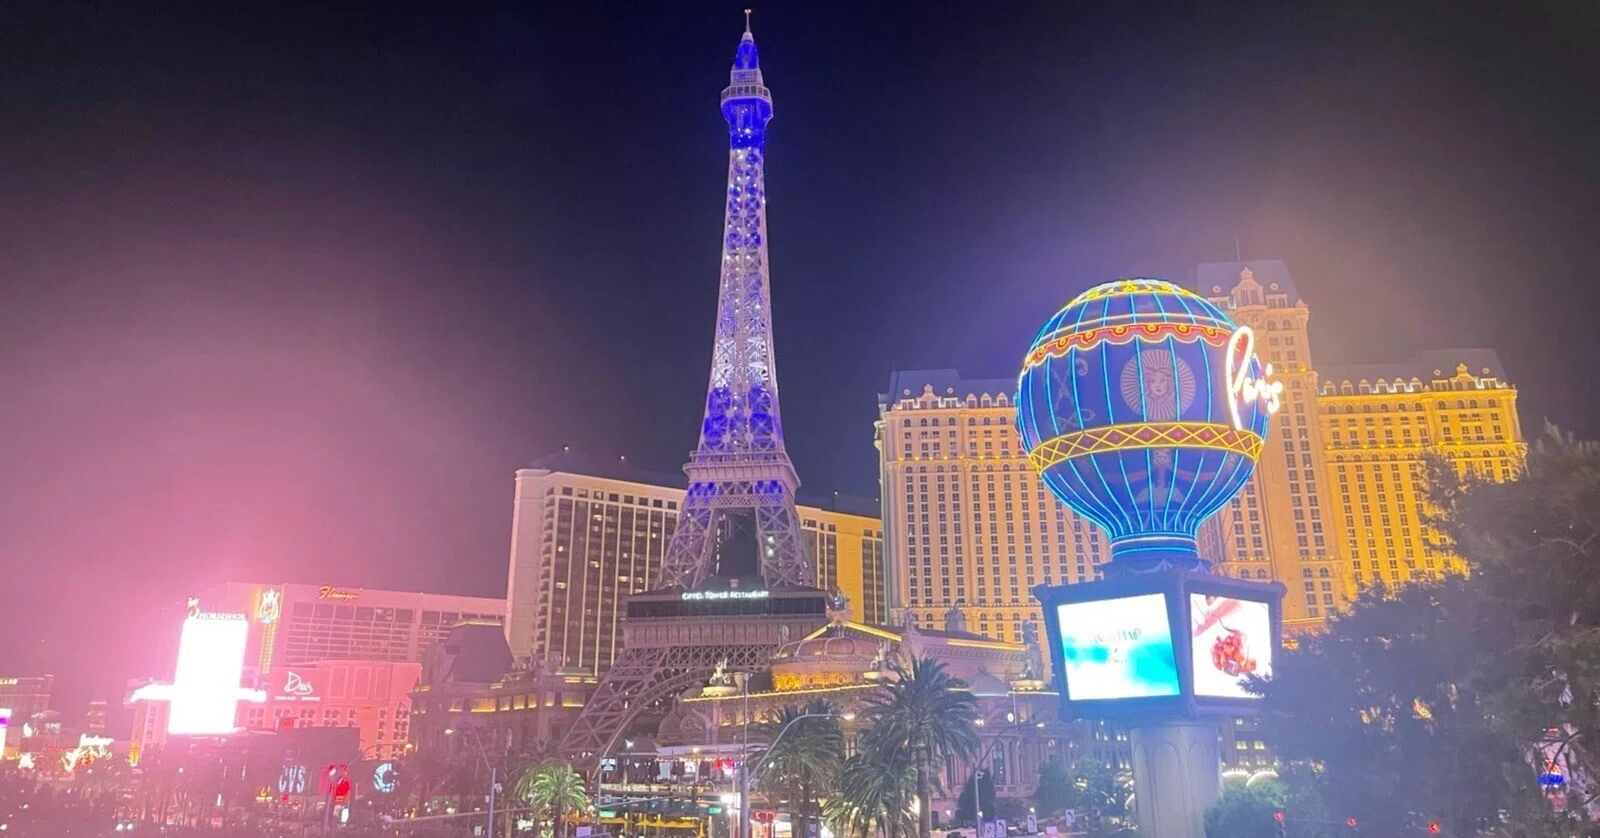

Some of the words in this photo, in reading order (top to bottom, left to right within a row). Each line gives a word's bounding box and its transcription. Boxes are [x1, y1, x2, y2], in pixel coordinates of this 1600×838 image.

[1226, 326, 1283, 430] Paris
[319, 585, 359, 601] Flamingo
[682, 592, 703, 600] EIFFEL
[704, 591, 728, 600] TOWER
[730, 590, 769, 599] RESTAURANT
[200, 612, 246, 620] HORSESHOE
[278, 764, 306, 793] CVS
